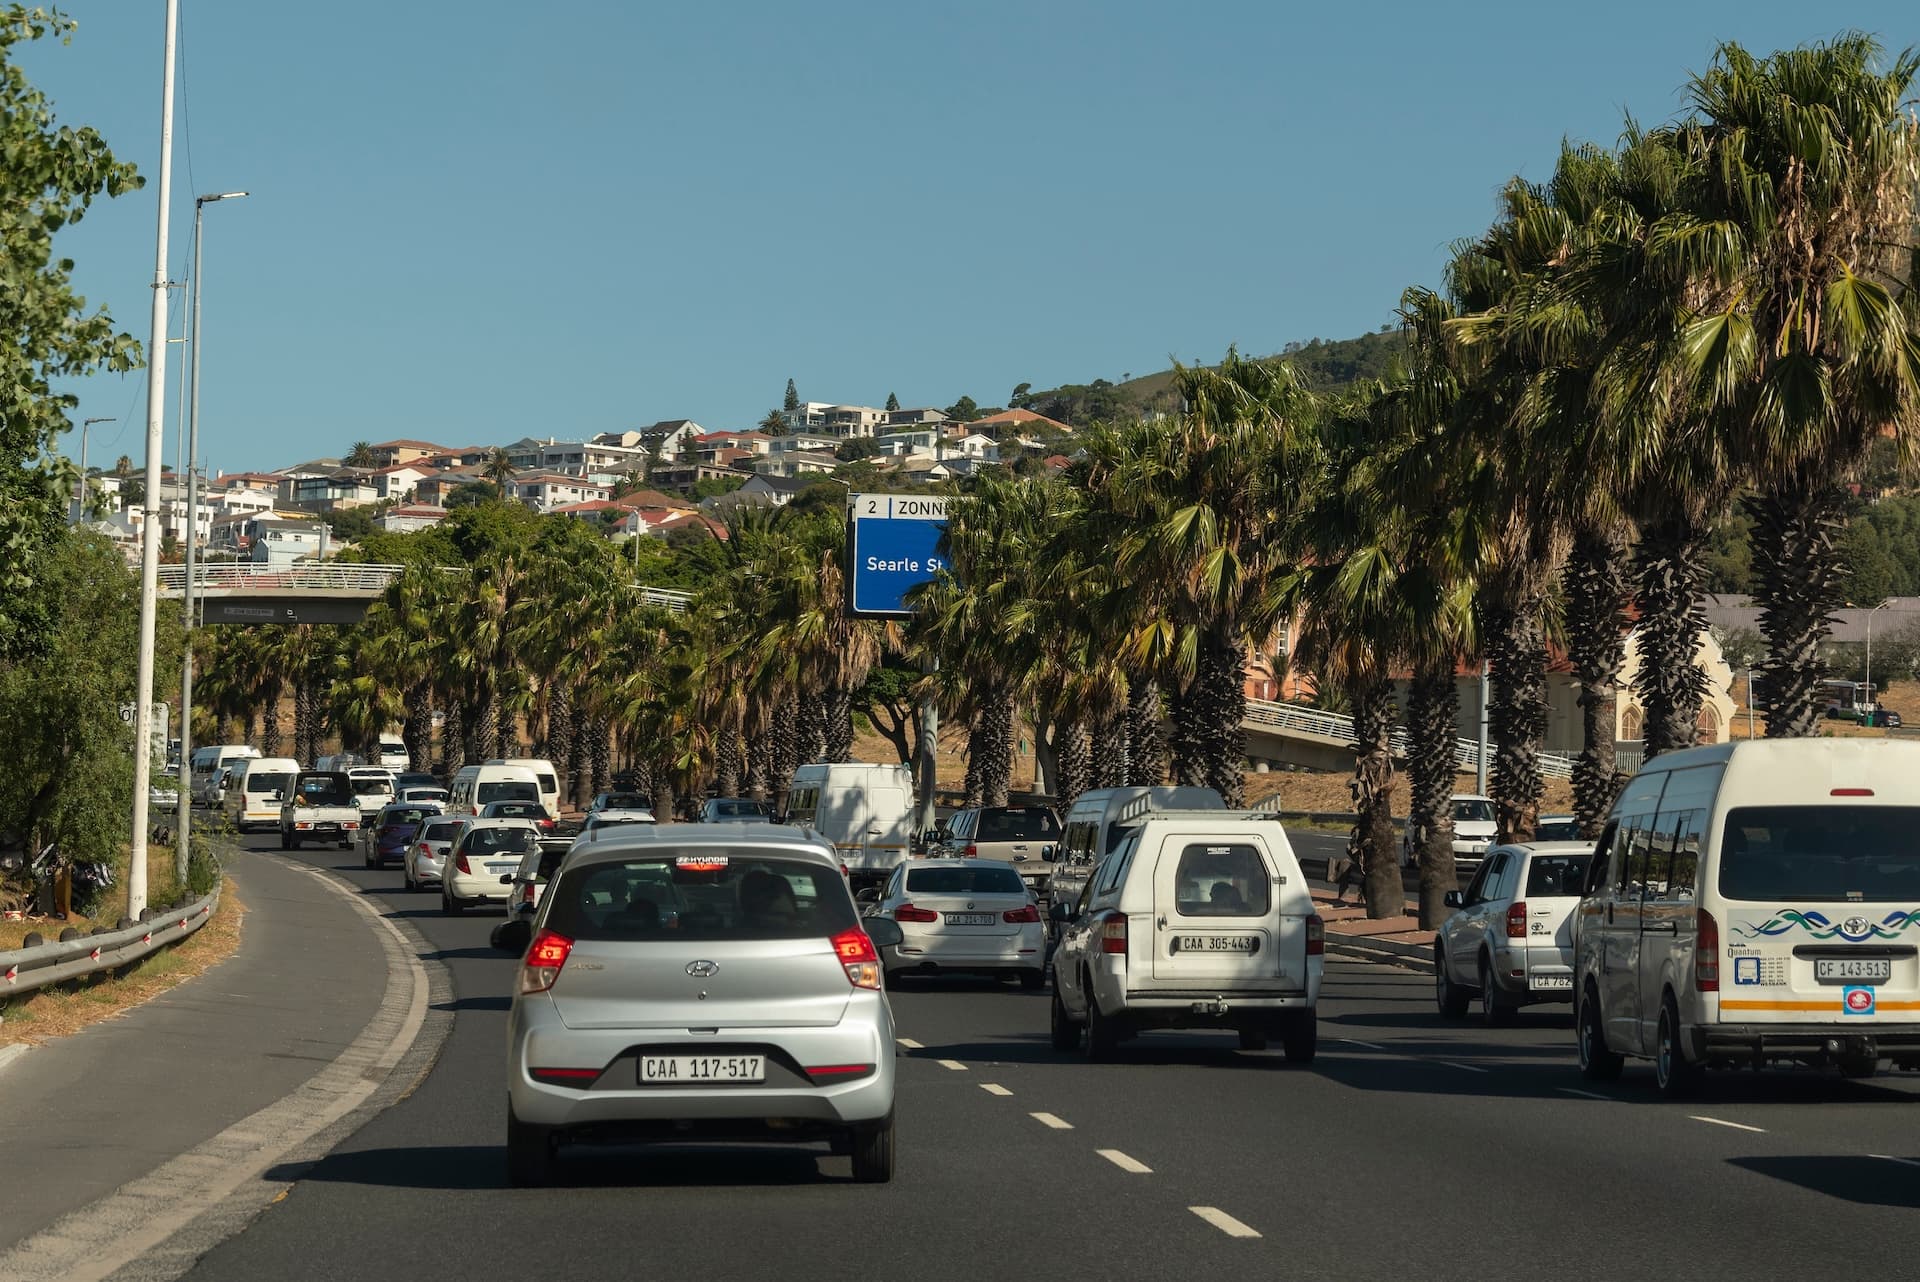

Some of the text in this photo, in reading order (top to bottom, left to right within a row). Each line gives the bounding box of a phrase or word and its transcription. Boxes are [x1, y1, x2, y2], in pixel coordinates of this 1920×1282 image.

[868, 501, 877, 514] 2
[899, 501, 949, 515] ZONN
[867, 557, 919, 571] Searle
[690, 856, 728, 864] HYUNDAI
[1184, 937, 1250, 950] CAA 305-443
[1728, 948, 1761, 958] Quantum
[1819, 962, 1888, 977] CF 143-513
[1537, 976, 1549, 986] CA
[647, 1058, 759, 1078] CAA 117-517
